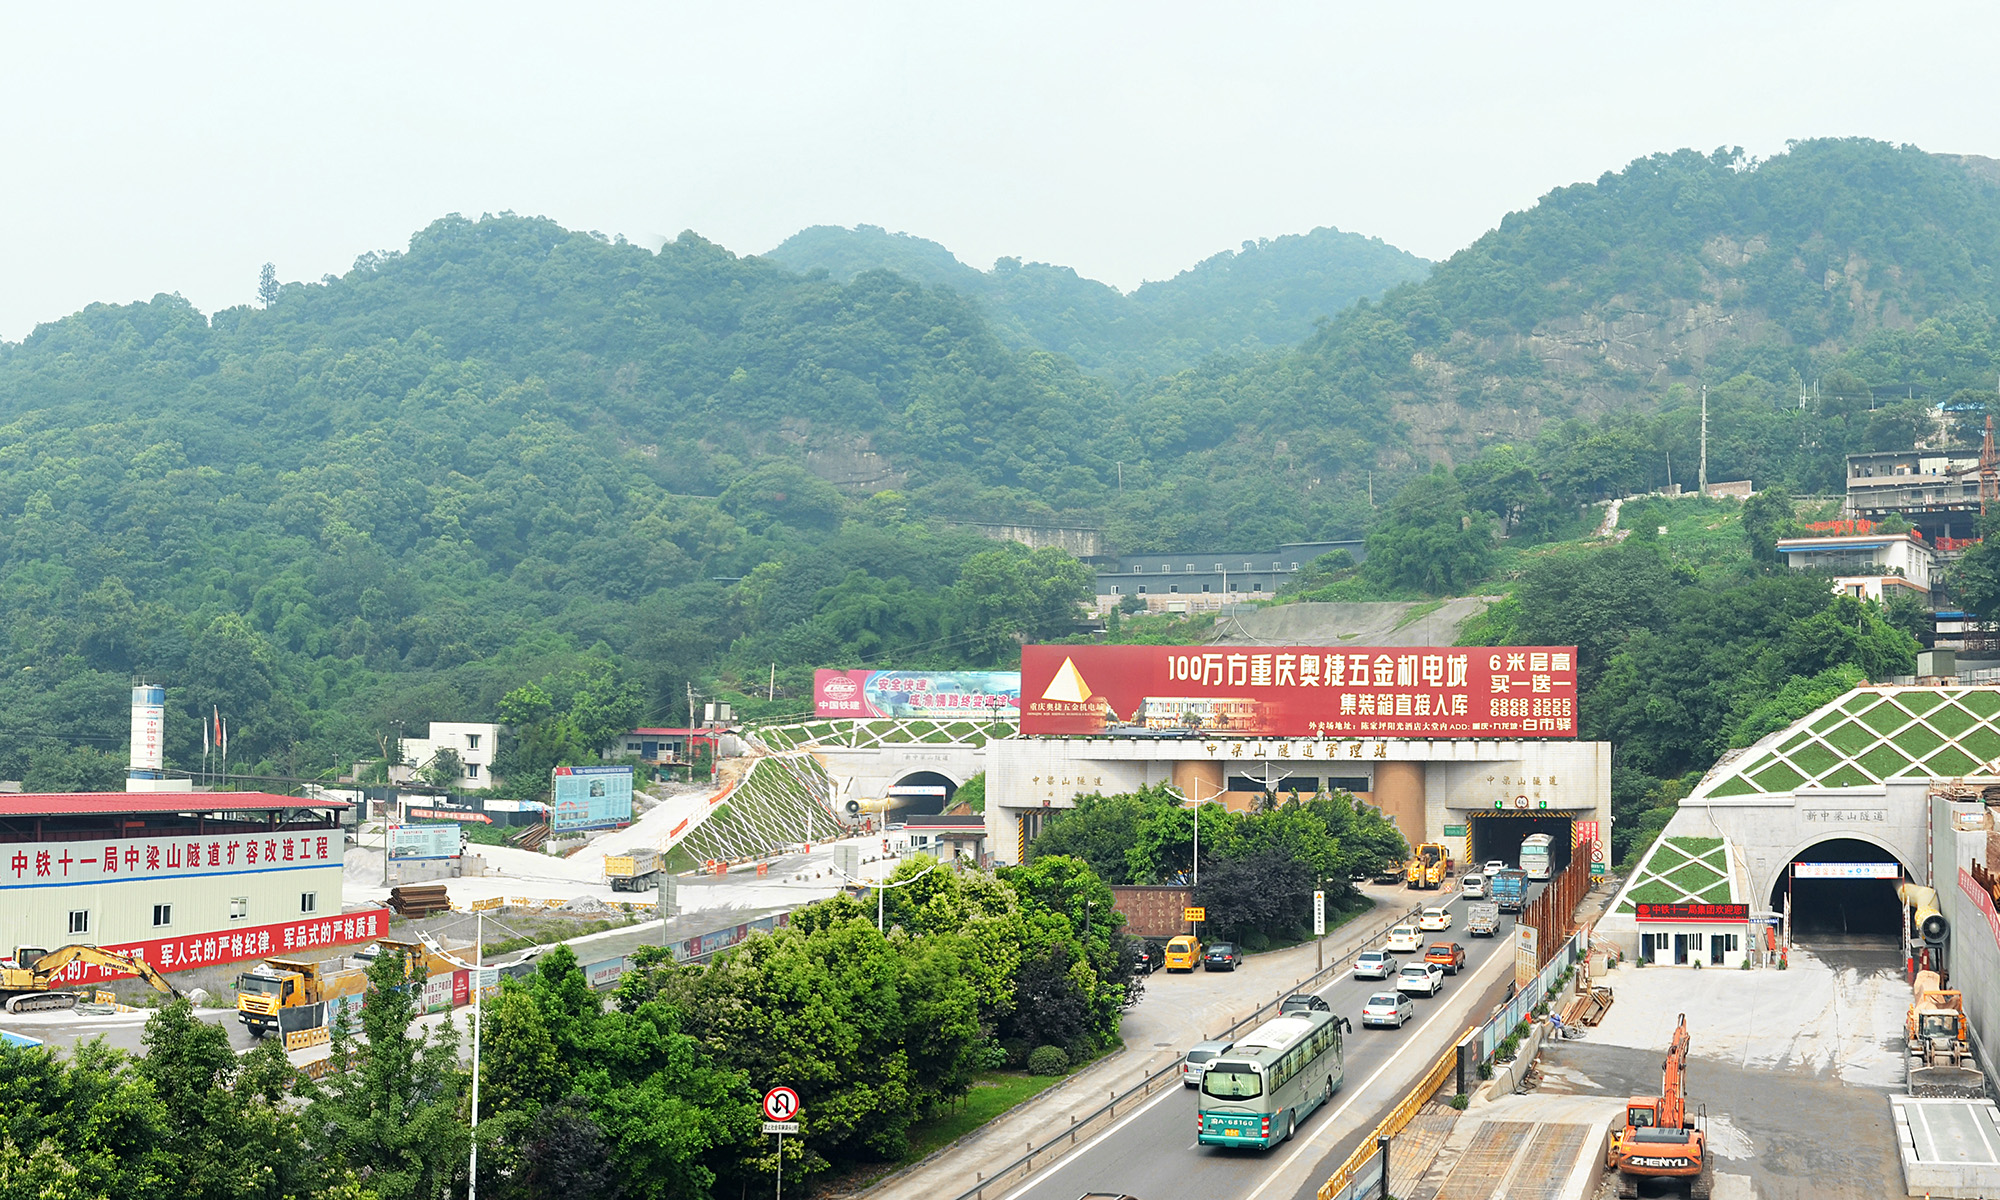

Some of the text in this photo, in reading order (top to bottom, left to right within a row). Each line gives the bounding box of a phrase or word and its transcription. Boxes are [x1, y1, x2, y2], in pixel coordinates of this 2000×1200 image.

[1168, 653, 1468, 687] 100万方重庆奥捷五金机电城
[878, 679, 927, 691] 安全快速
[1490, 674, 1572, 693] 买一送一
[819, 700, 860, 710] 中国铁建
[1340, 693, 1468, 716] 集装箱直接入库
[1490, 698, 1571, 708] 6868 3555
[1490, 707, 1571, 717] 6868 8555
[1206, 743, 1387, 758] 中梁山隧道管理站
[1806, 810, 1884, 821] 新中梁山隧道
[12, 836, 328, 878] 中铁十一局中梁山隧道扩容改造工程
[1631, 1156, 1688, 1167] ZHENYU
